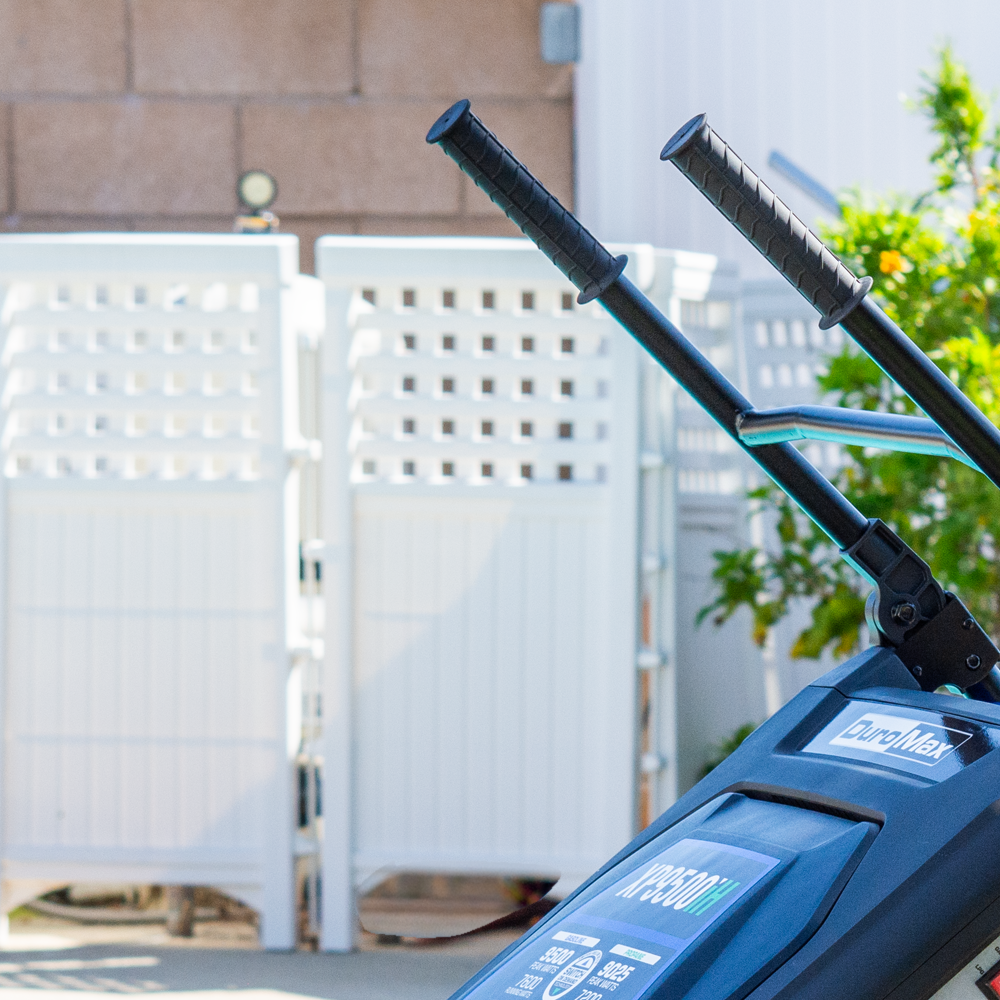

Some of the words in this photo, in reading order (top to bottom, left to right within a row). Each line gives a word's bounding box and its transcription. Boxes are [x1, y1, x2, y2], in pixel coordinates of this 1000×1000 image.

[840, 719, 953, 759] DuroMax
[615, 863, 741, 916] XP9500iH
[539, 946, 575, 965] 9500
[529, 961, 545, 972] PEAK
[540, 964, 560, 974] WATTS
[597, 961, 635, 982] 9025
[974, 963, 985, 975] LPG
[515, 974, 543, 990] 7600
[586, 976, 603, 986] PEAK
[599, 980, 619, 992] WATTS
